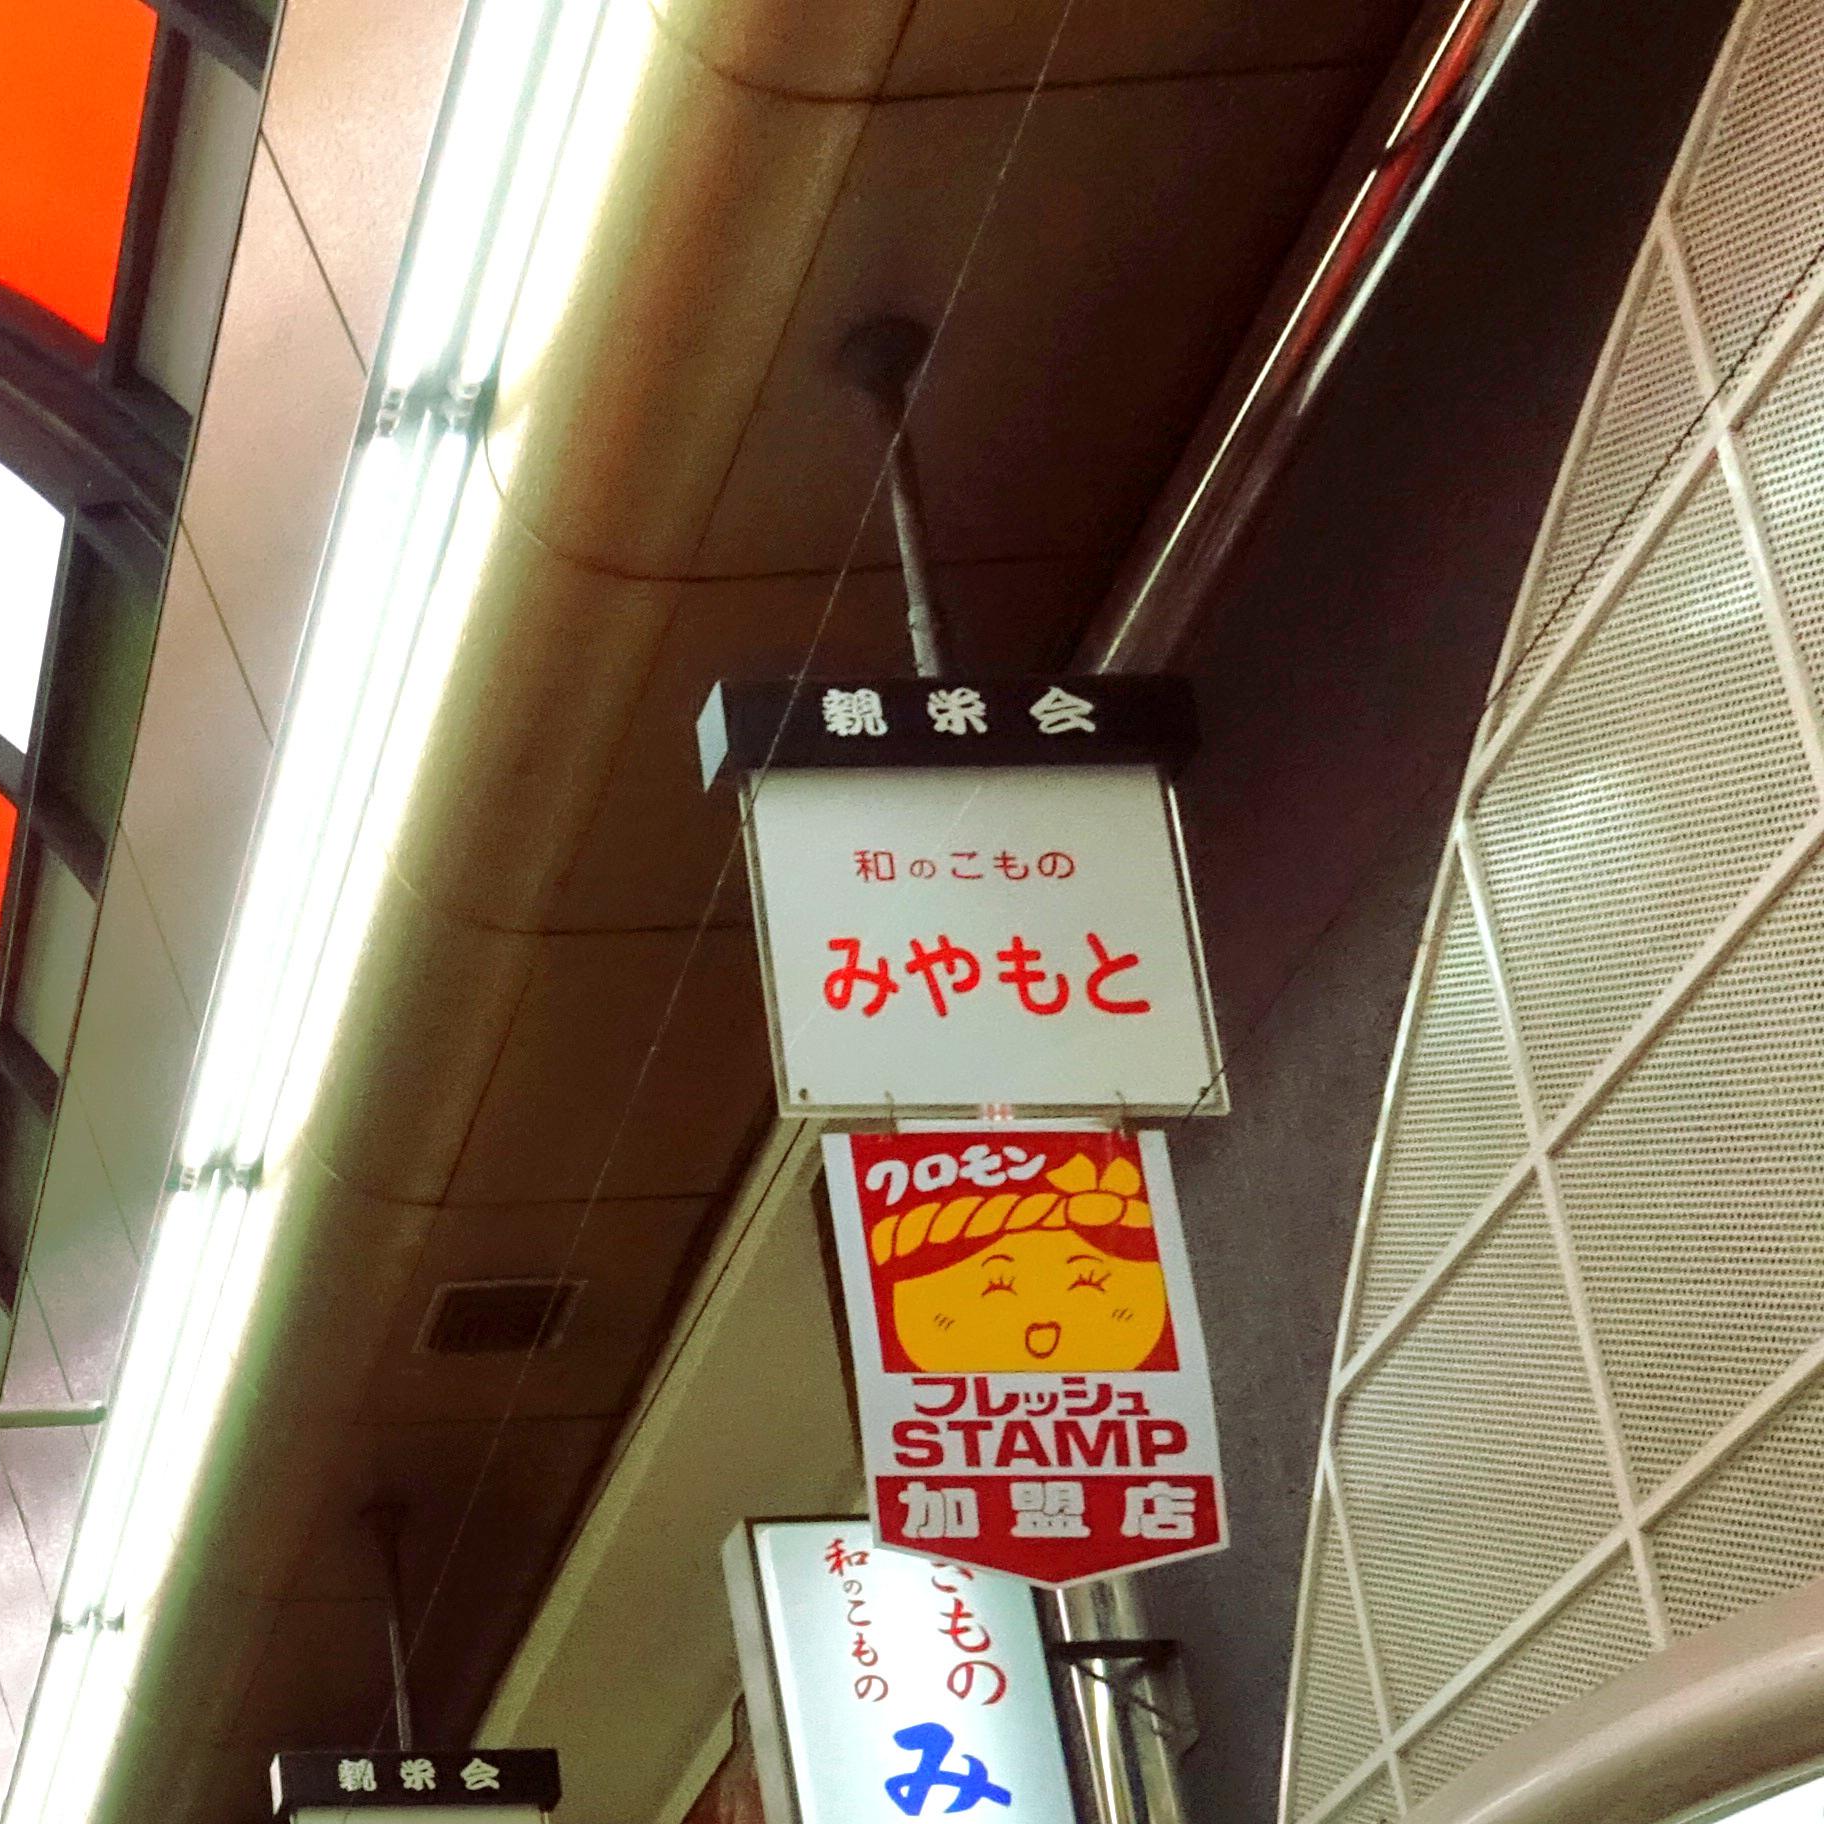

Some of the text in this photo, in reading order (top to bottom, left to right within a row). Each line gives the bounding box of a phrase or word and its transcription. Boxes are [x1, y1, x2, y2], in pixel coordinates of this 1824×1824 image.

[821, 685, 1096, 740] 親栄会
[854, 847, 1077, 885] 和のこもの
[823, 932, 1151, 1018] みやもと
[864, 1142, 1047, 1207] クロモン
[912, 1376, 1151, 1419] フレッシュ
[891, 1418, 1188, 1470] STAMP
[898, 1480, 1196, 1541] 加盟店
[822, 1536, 892, 1705] 和のこもの
[337, 1756, 502, 1793] 親栄会
